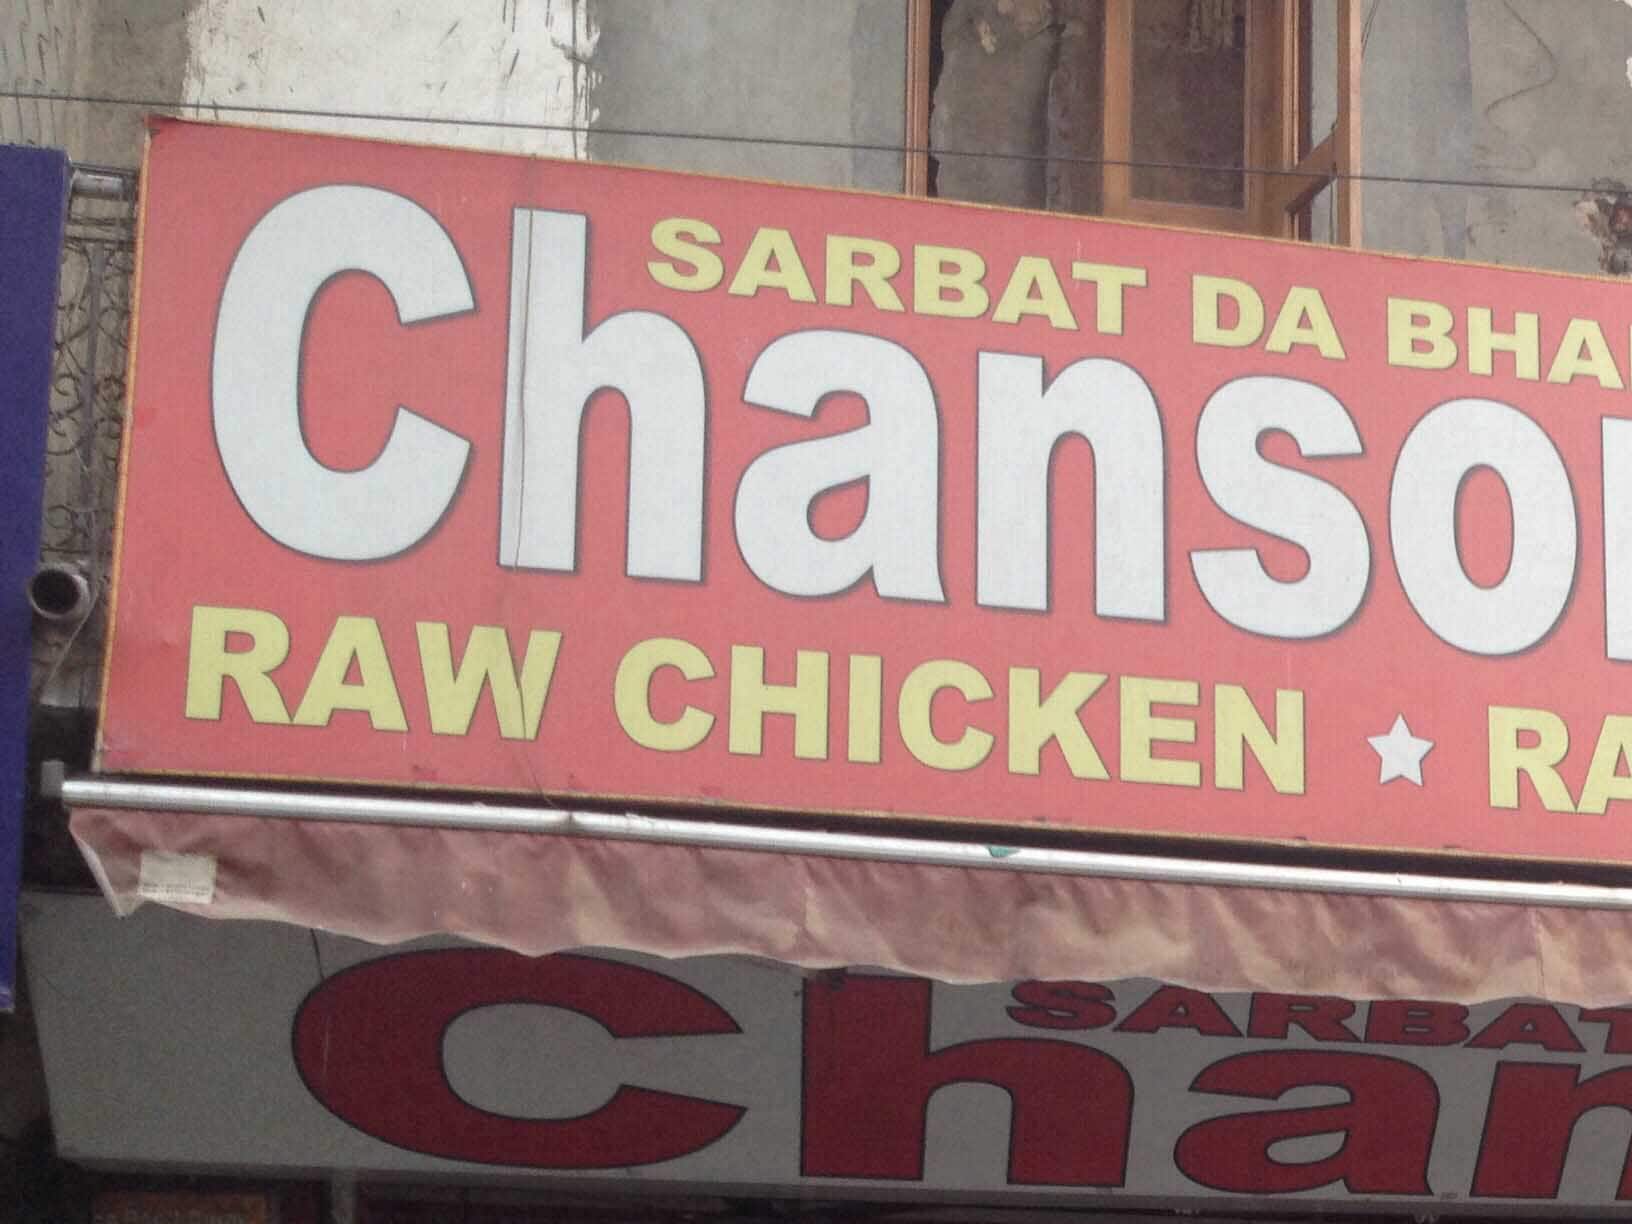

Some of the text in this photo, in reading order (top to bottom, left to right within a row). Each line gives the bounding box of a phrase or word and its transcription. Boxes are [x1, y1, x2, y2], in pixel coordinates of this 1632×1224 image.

[647, 216, 1147, 336] SARBAT
[1191, 274, 1346, 361] DA
[184, 605, 563, 742] RAW
[613, 637, 1306, 796] CHICKEN
